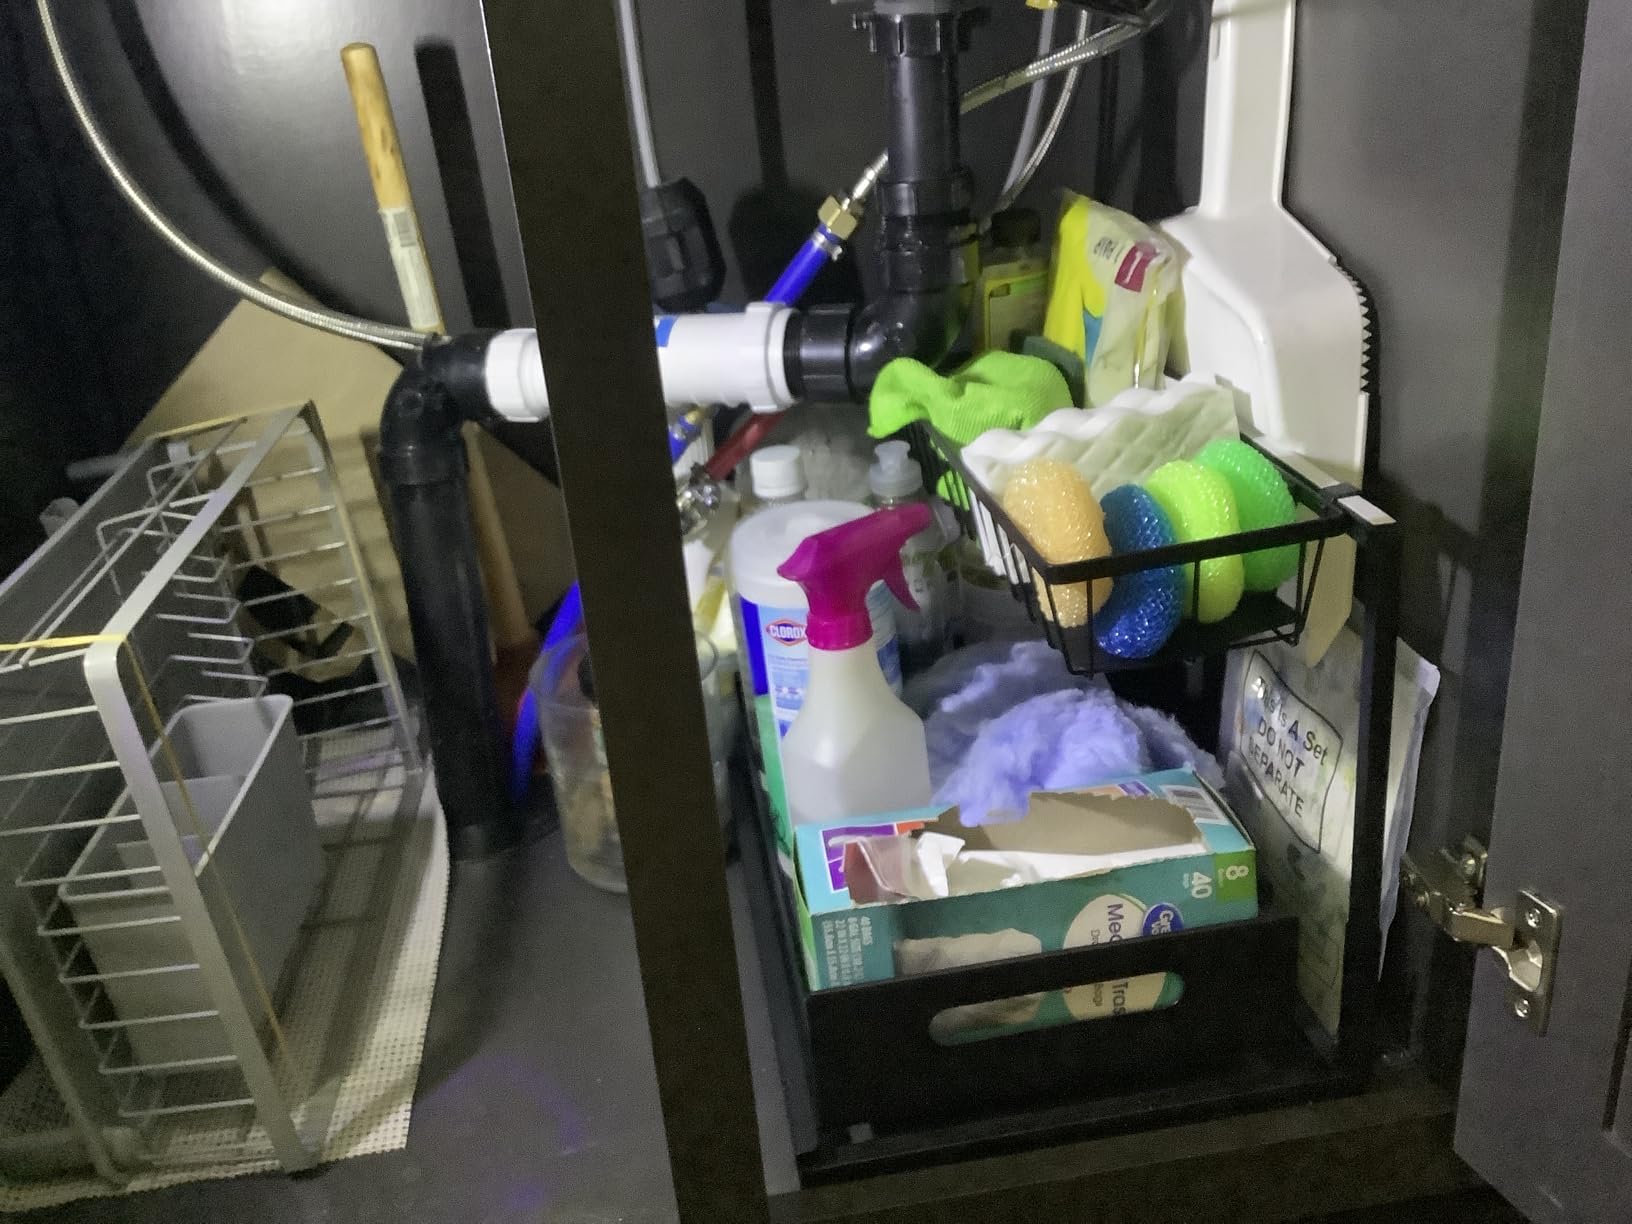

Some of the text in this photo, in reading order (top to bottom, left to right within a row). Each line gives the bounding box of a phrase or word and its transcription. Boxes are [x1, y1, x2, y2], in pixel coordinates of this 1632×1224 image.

[769, 624, 808, 640] CLOROX
[1258, 716, 1305, 777] DO NOT
[1288, 719, 1299, 741] A
[1303, 731, 1328, 766] Set
[1249, 735, 1304, 818] SEPARATE
[1192, 872, 1212, 898] 40
[1226, 865, 1249, 880] 8
